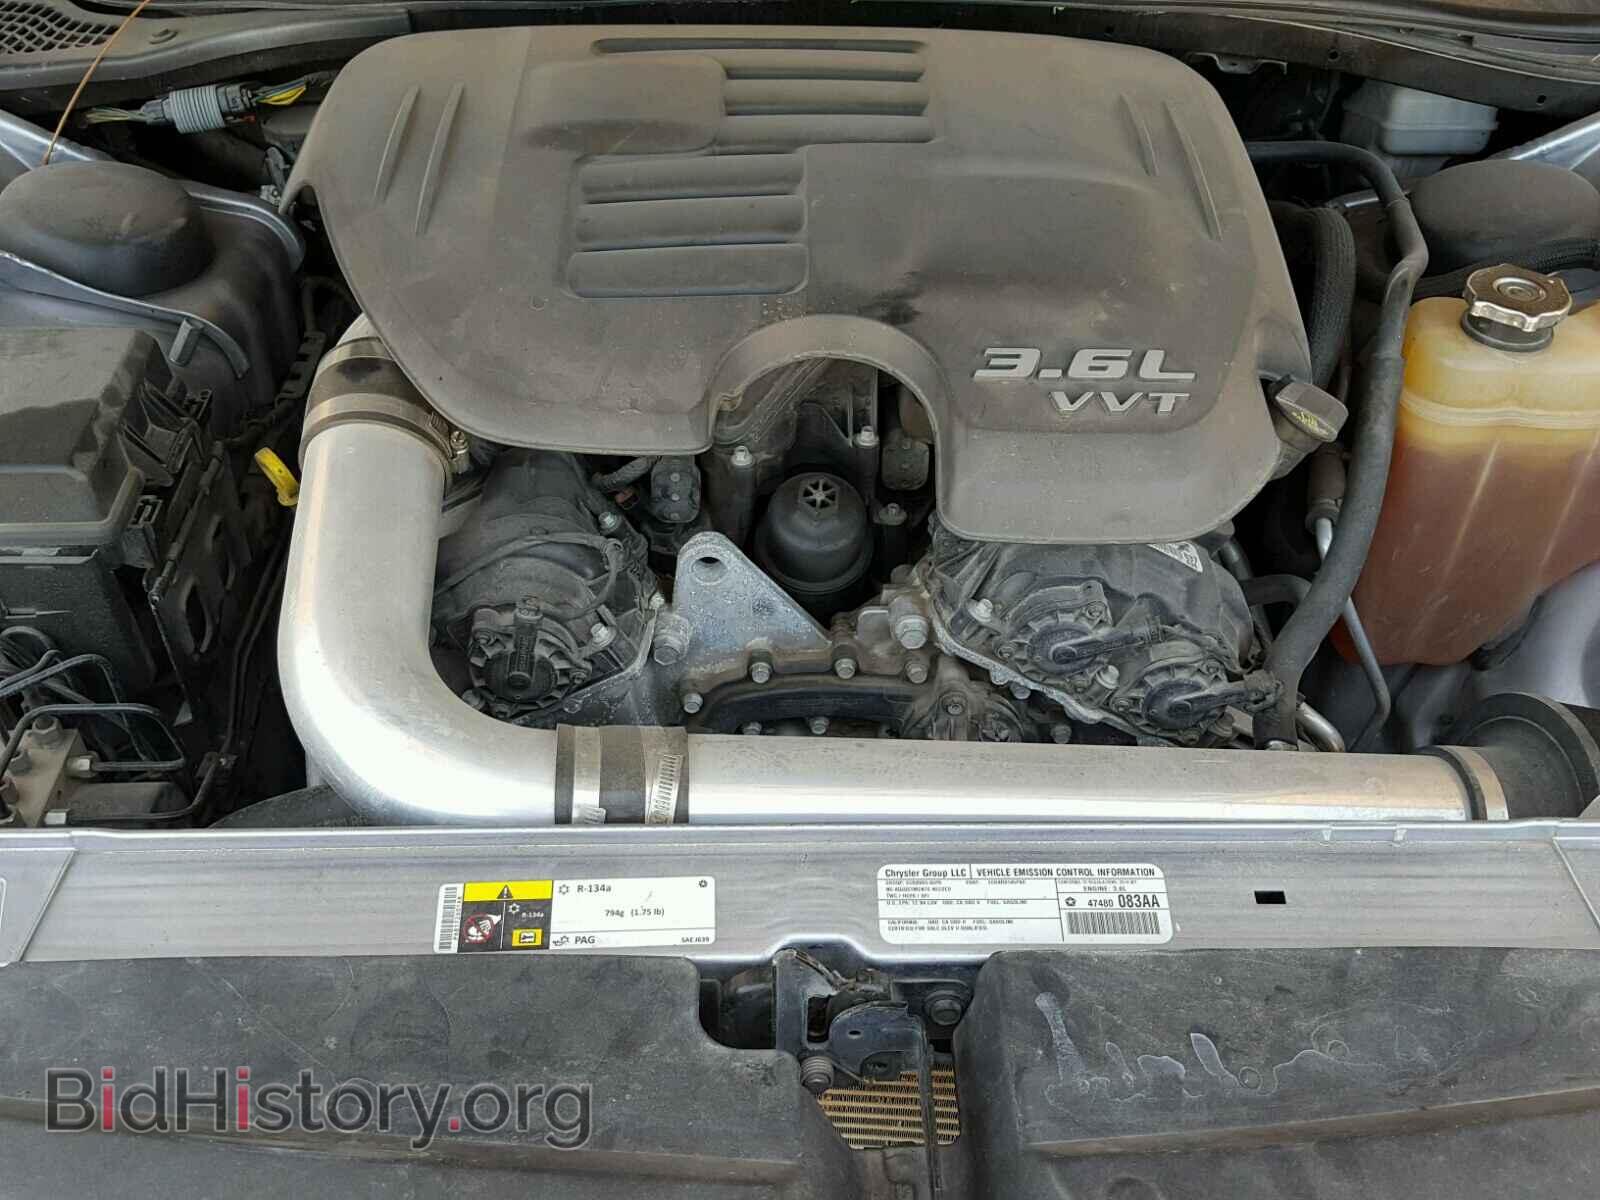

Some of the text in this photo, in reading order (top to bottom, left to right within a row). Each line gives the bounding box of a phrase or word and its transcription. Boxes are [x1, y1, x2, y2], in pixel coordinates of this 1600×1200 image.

[974, 347, 1196, 381] 3.6L
[1048, 391, 1191, 416] VVT
[885, 868, 967, 879] Chrysler Group LLC
[977, 868, 1155, 877] VEHICLE EMISSION CONTROL INFORMATION
[577, 883, 612, 893] R-134a
[1087, 894, 1160, 908] 47480 083AA
[605, 909, 625, 918] 794g
[574, 935, 596, 945] PAG
